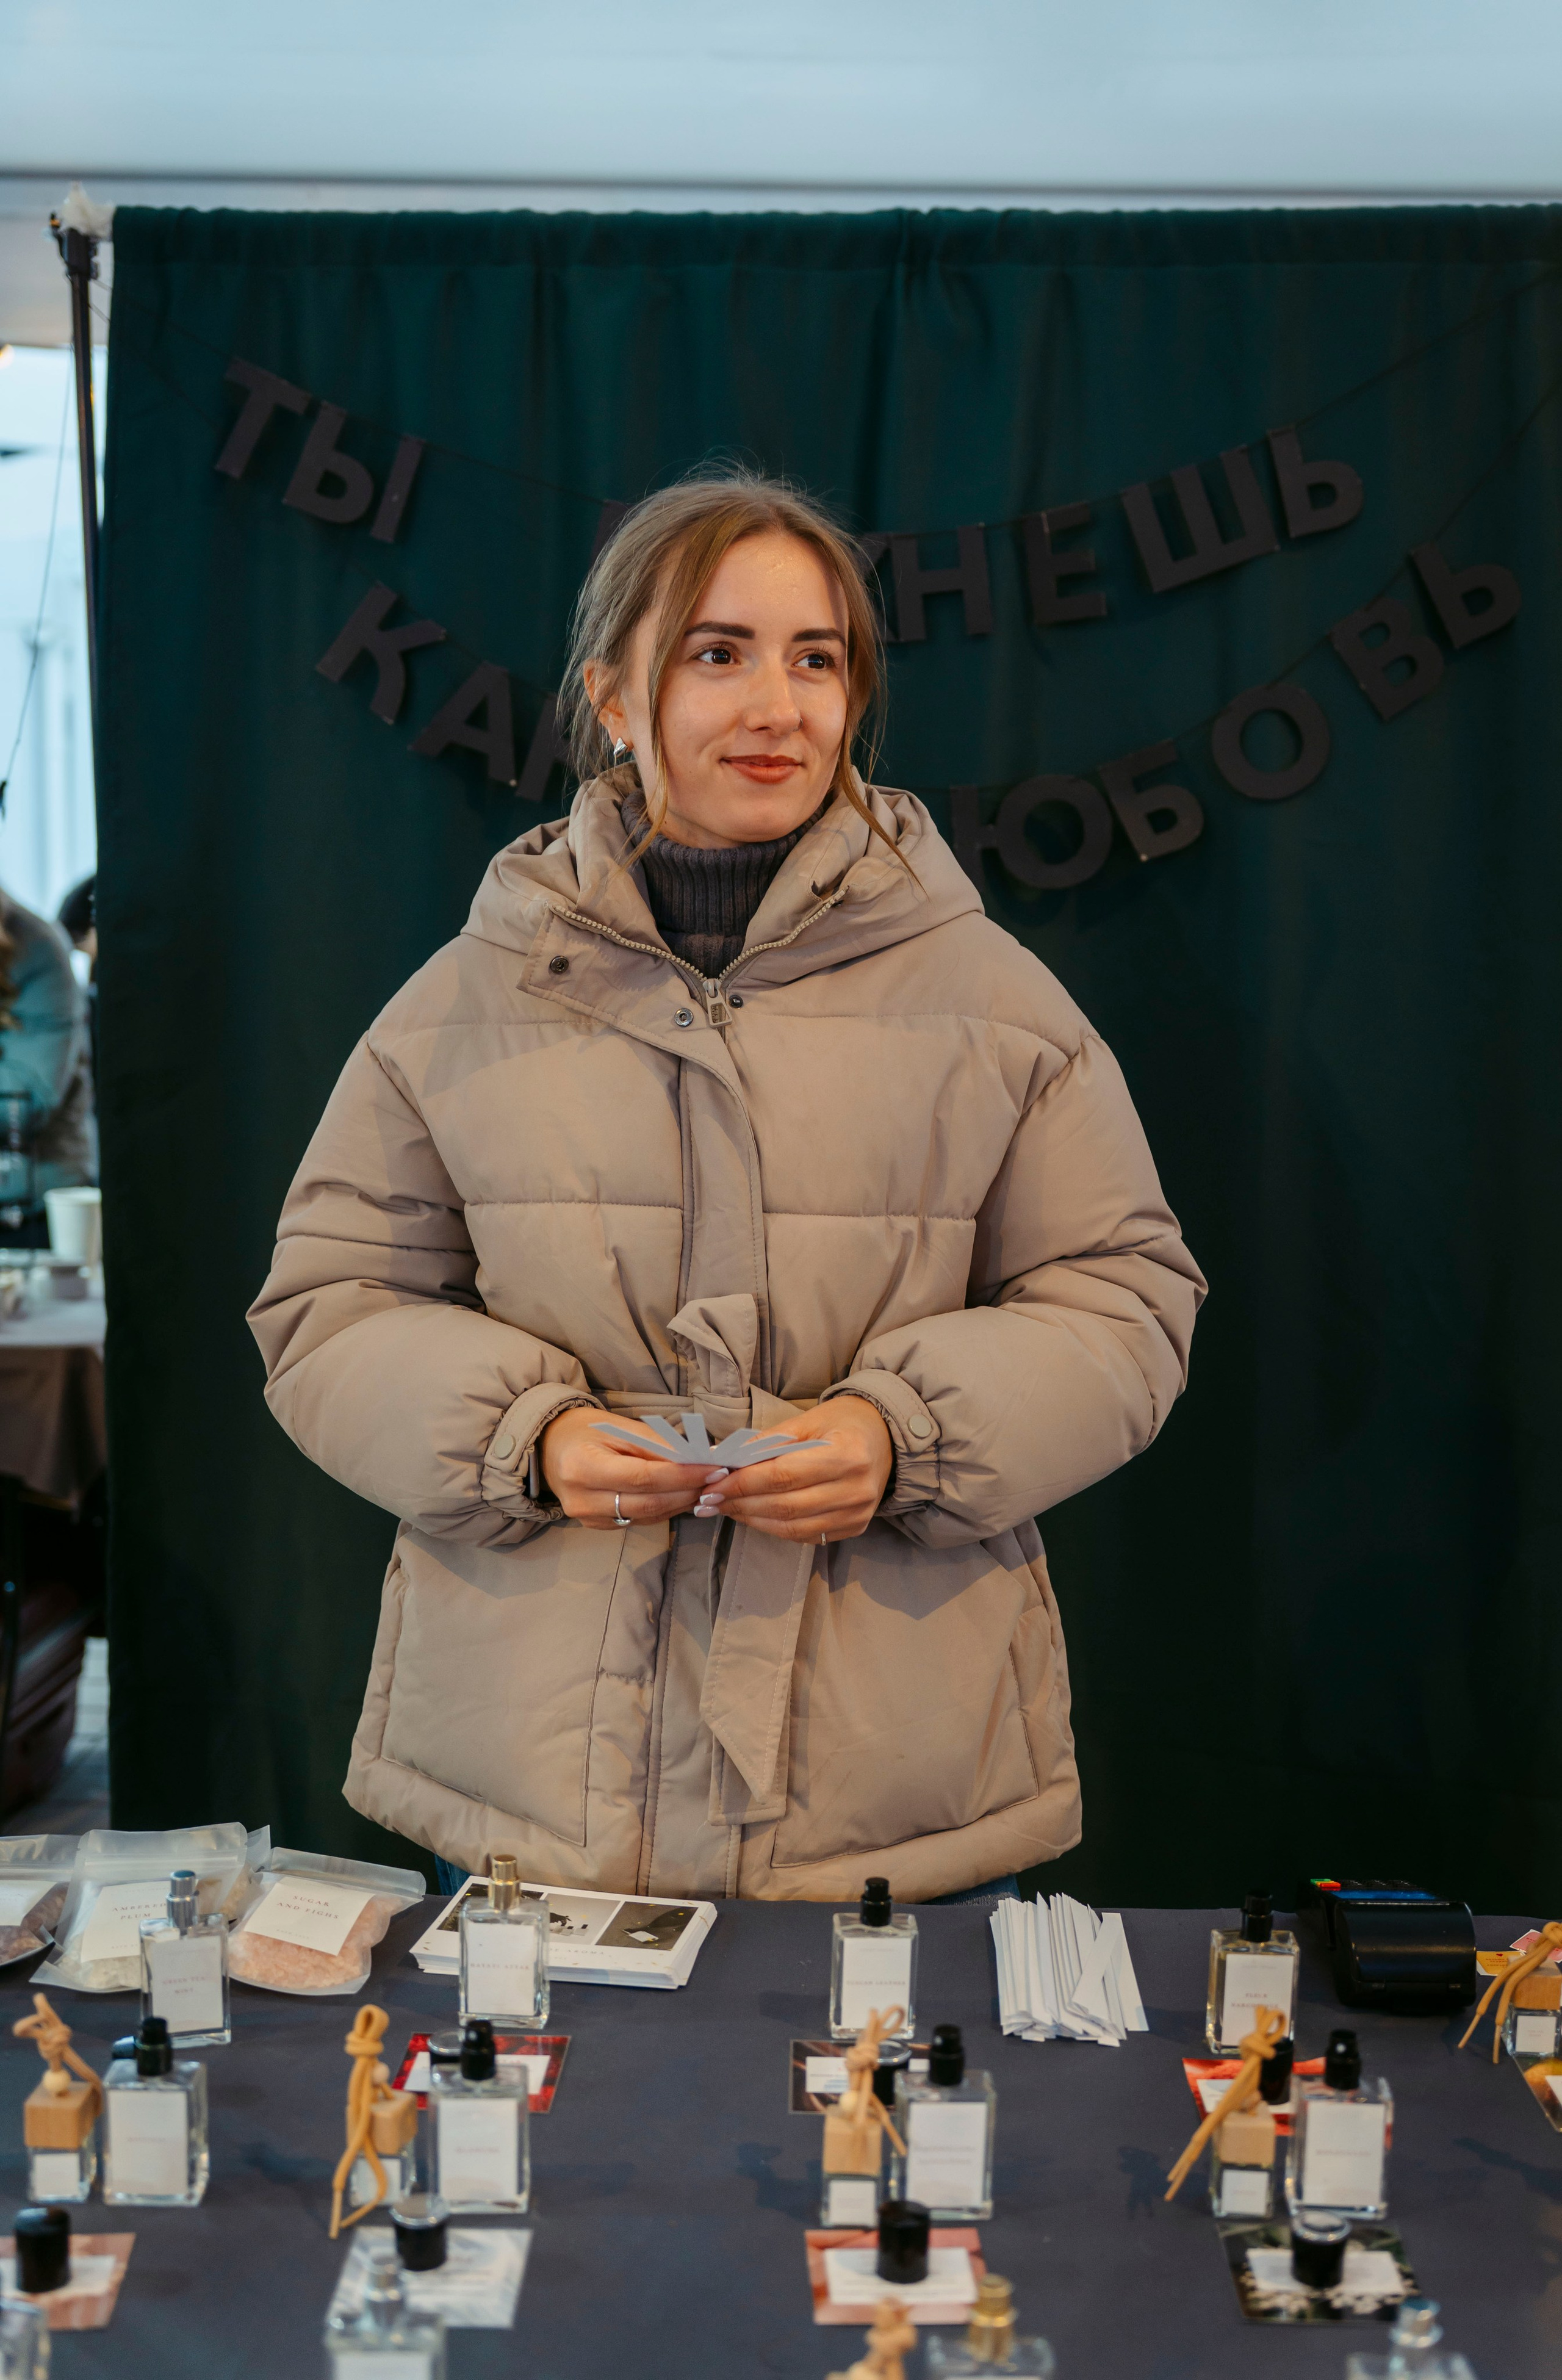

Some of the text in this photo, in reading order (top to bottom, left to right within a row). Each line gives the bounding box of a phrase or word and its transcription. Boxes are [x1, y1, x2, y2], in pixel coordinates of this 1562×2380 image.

[214, 355, 1364, 643] ТЫ НЕШЬ
[949, 541, 1522, 890] ЮБОВЬ
[112, 1903, 167, 1912] AMBERED
[292, 1895, 329, 1907] SUGAR
[276, 1902, 339, 1919] AND FIGHS
